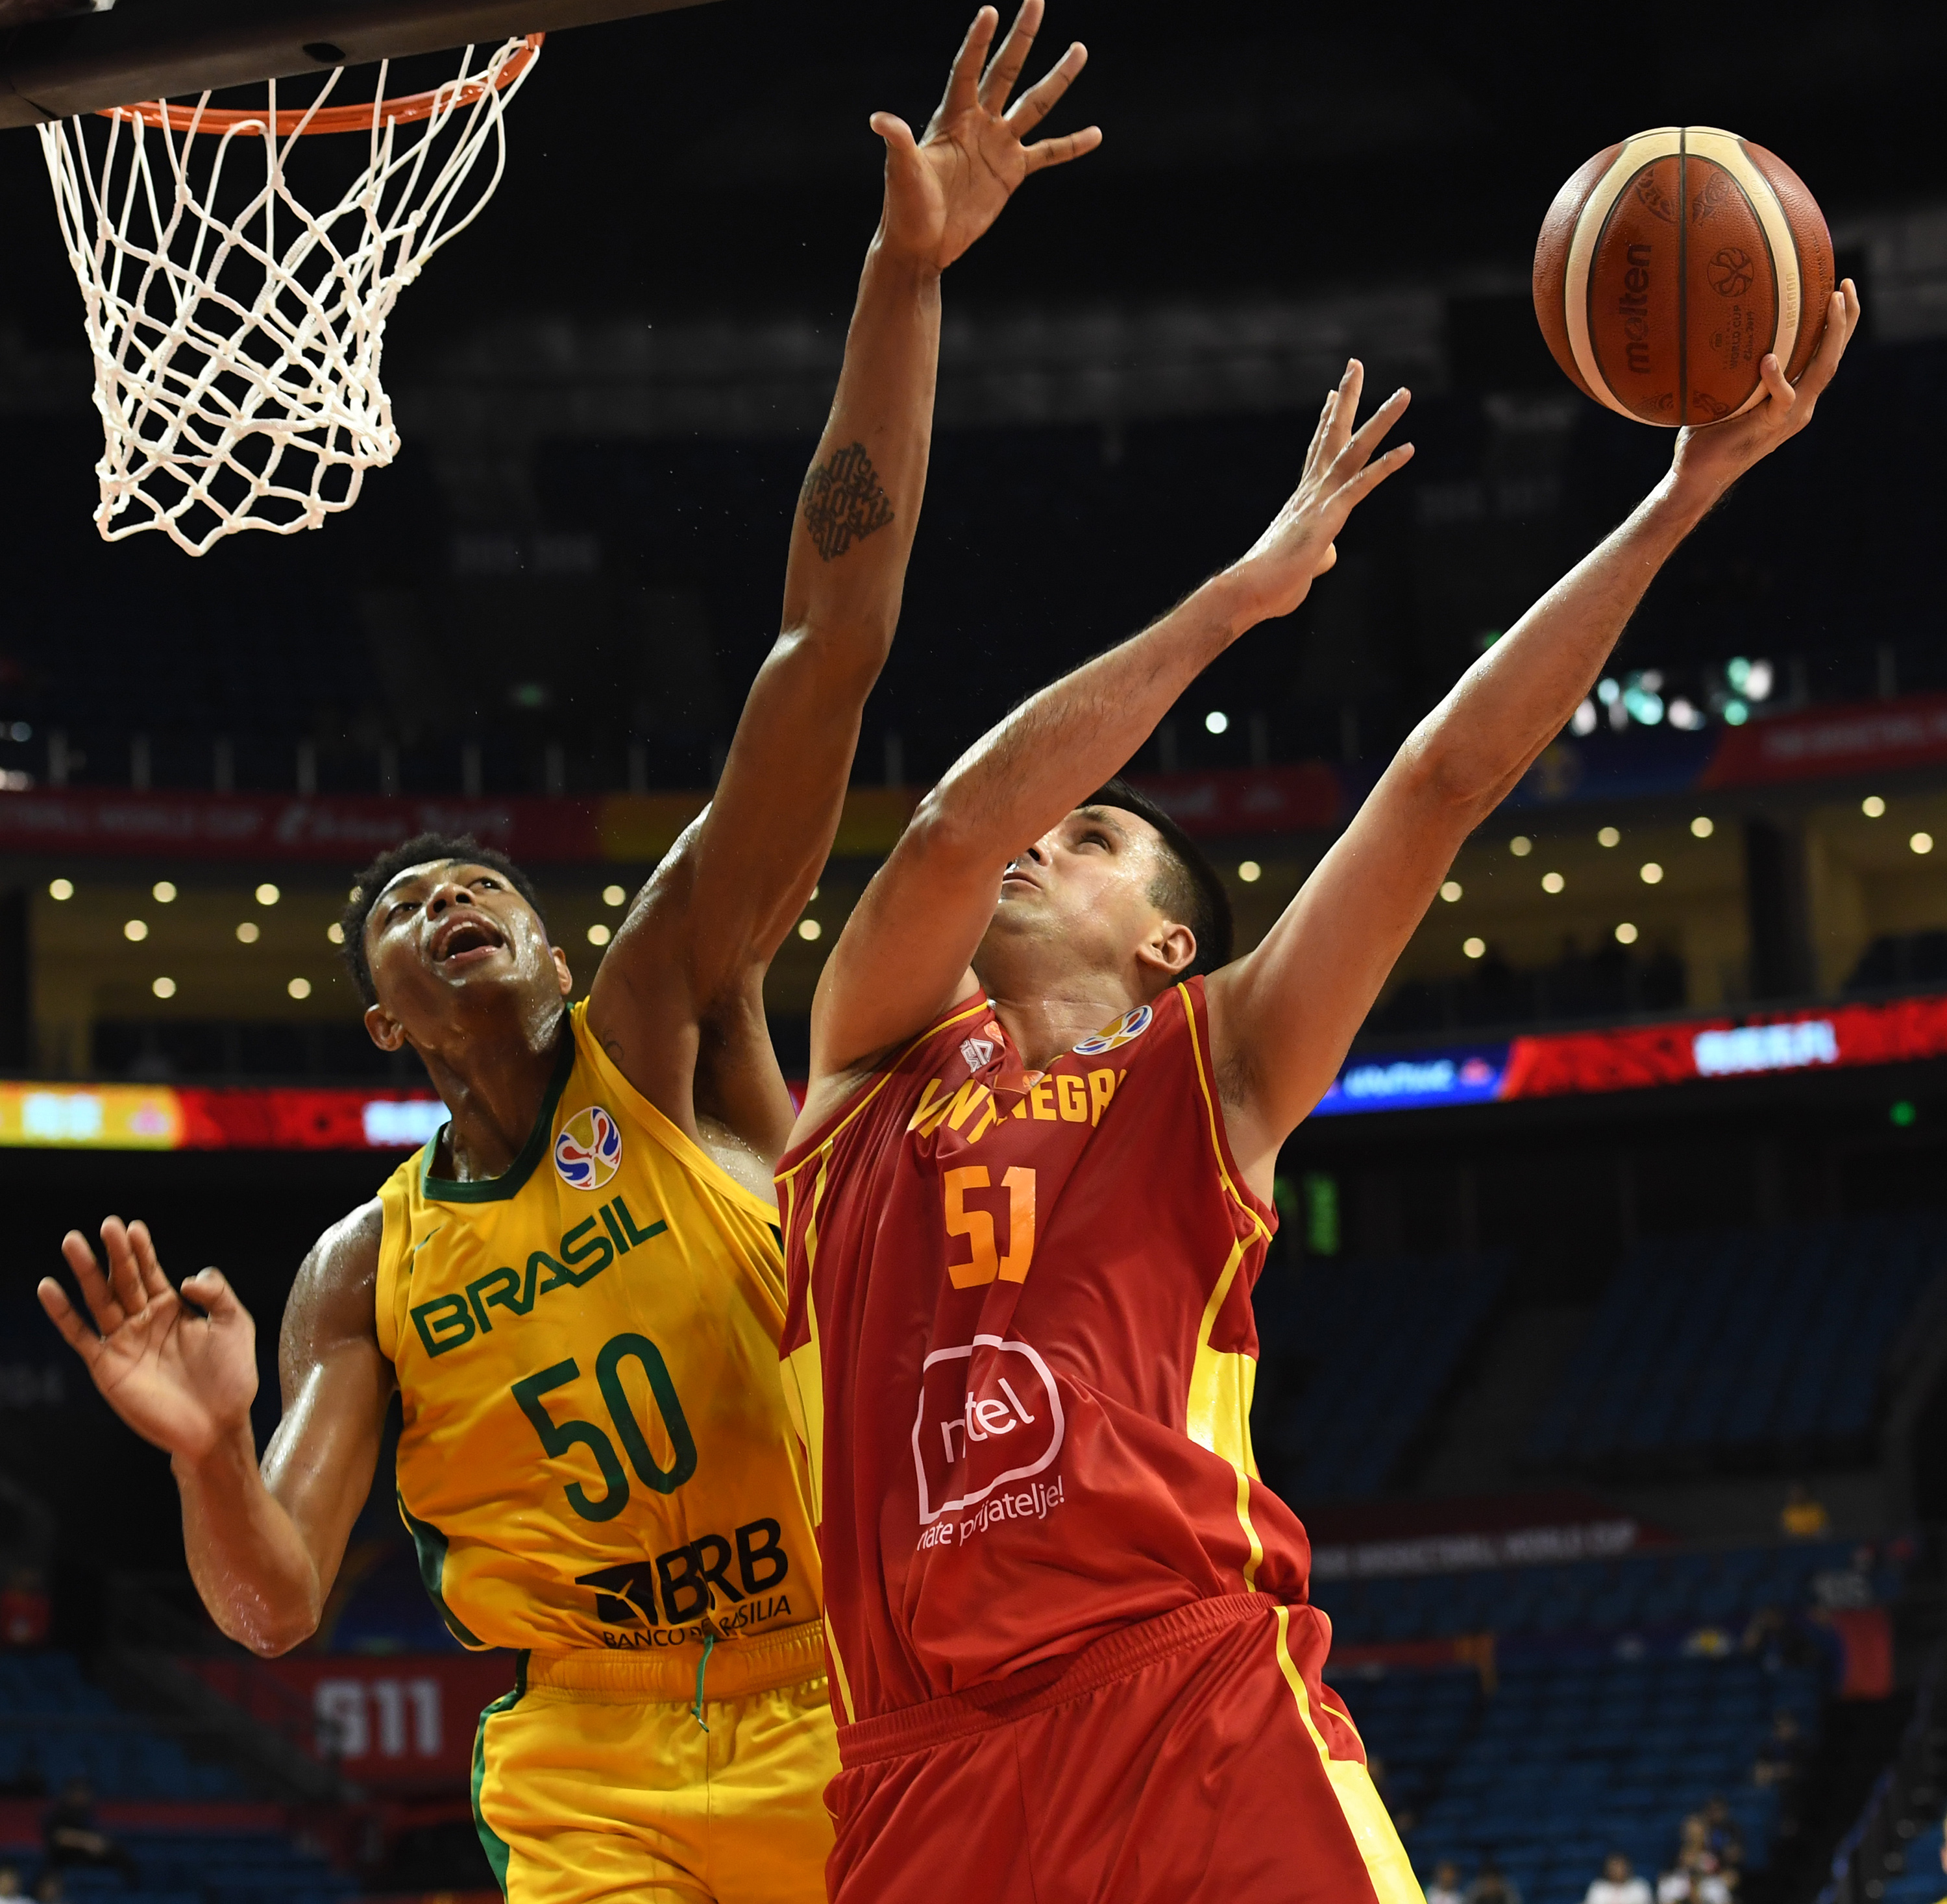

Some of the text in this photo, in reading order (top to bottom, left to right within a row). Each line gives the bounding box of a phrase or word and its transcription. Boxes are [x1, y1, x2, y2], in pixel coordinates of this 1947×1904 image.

[1619, 244, 1652, 374] molten
[1729, 305, 1741, 370] WORLD CUP
[410, 1195, 668, 1359] BRASIL
[944, 1166, 1036, 1290] 51
[511, 1332, 698, 1523] 50
[655, 1518, 789, 1626] BRB
[603, 1629, 685, 1648] BANCO
